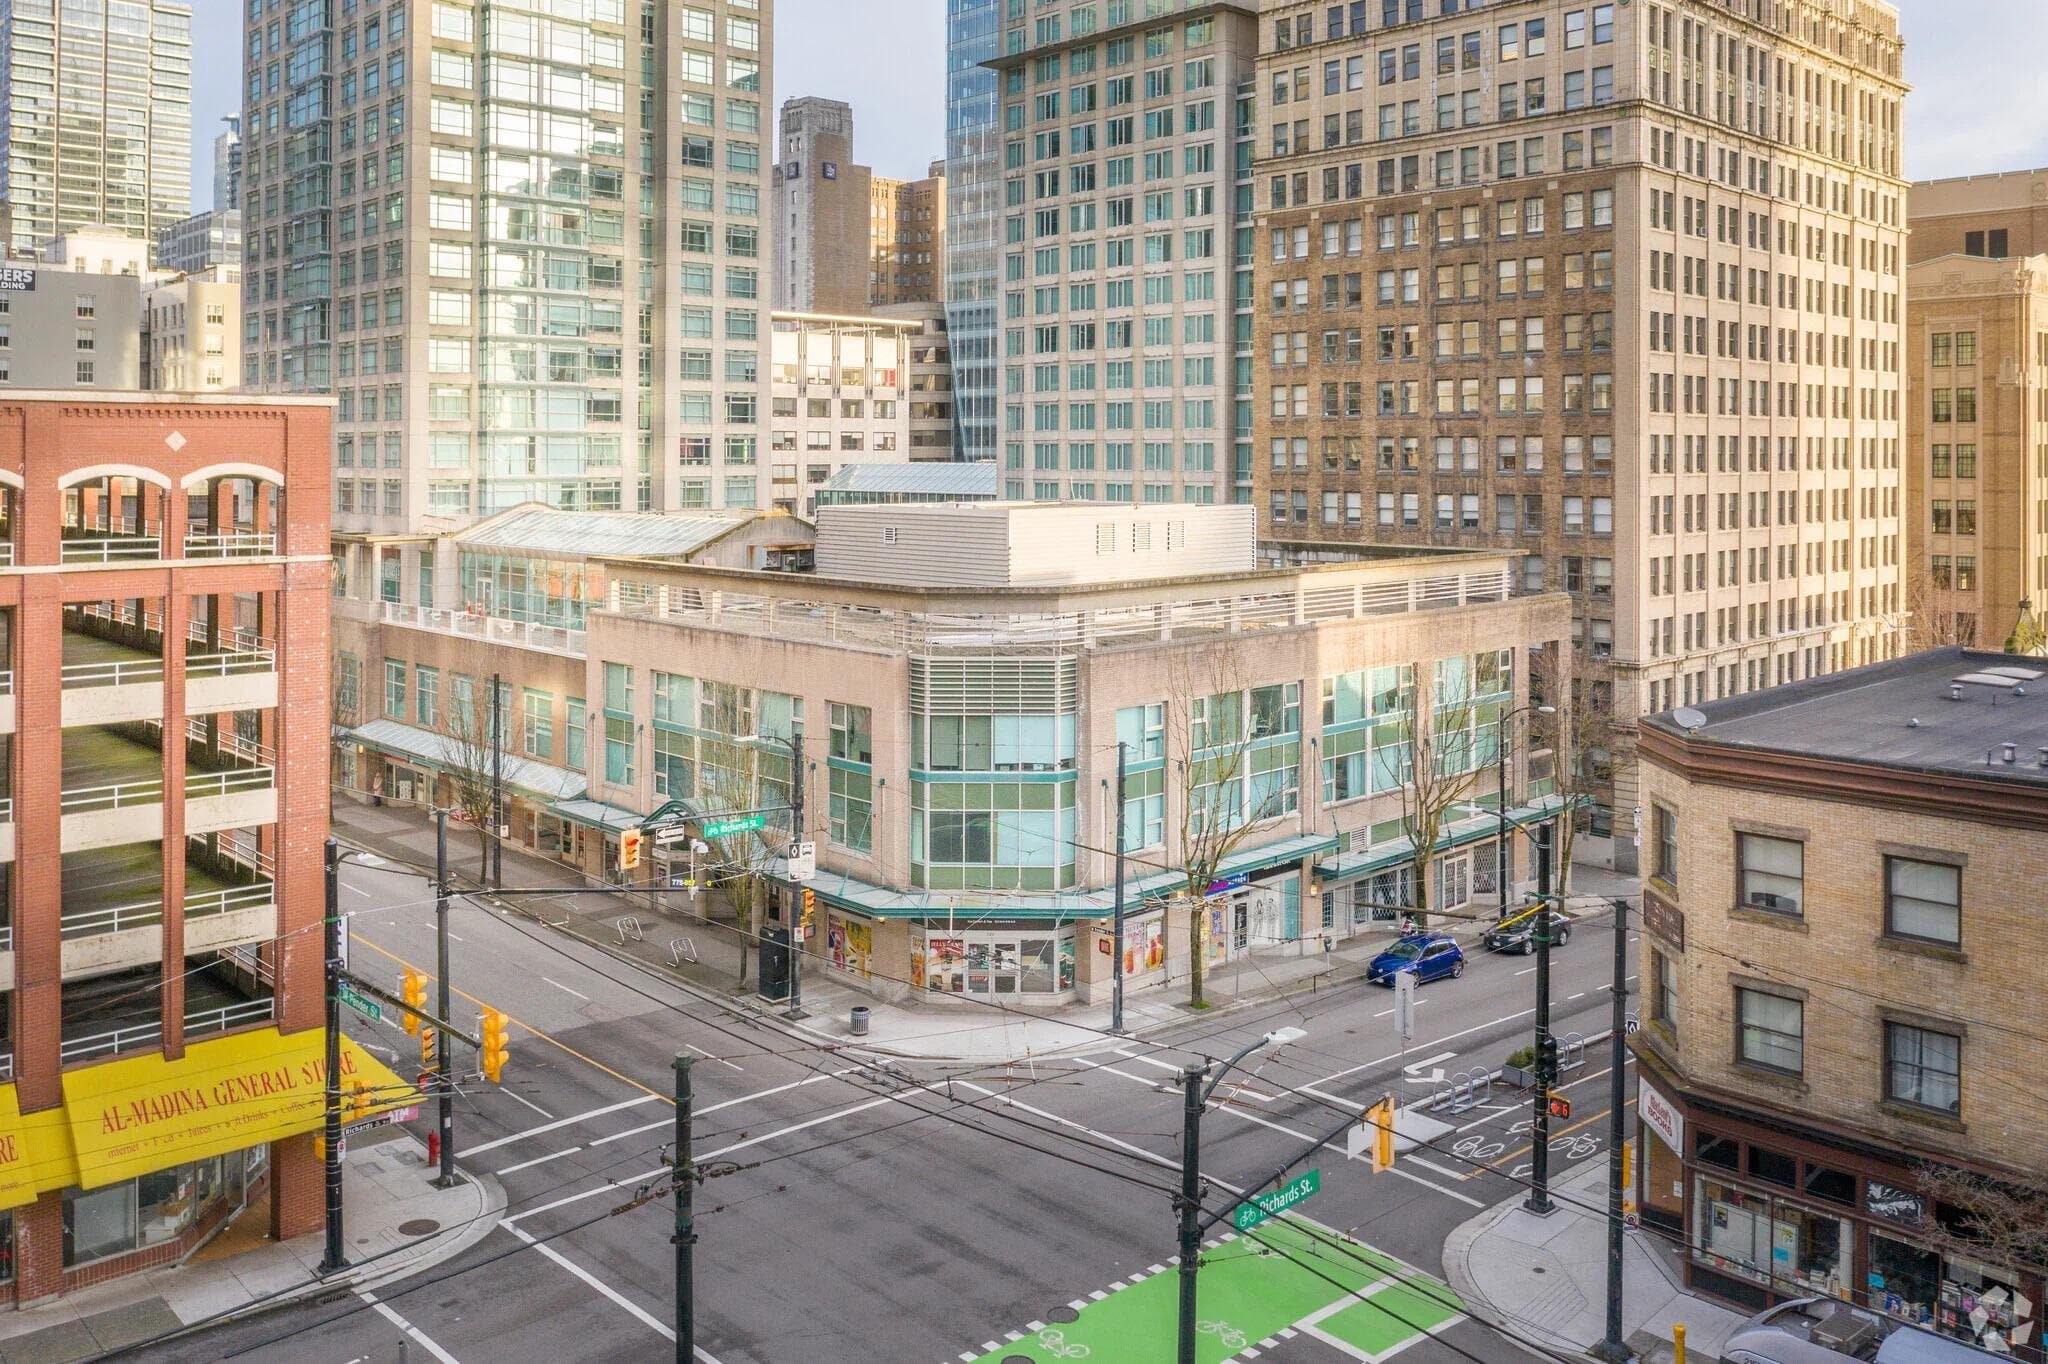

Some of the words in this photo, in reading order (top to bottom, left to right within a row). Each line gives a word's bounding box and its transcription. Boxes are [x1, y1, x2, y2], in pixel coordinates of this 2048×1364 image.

[0, 281, 25, 289] DING
[350, 993, 369, 1012] Pender
[102, 1087, 208, 1134] AL-MADINA
[213, 1066, 297, 1106] GENERAL
[387, 1106, 409, 1124] ATM
[1647, 1105, 1673, 1137] BOOKS
[345, 1120, 373, 1135] Richards
[1260, 1185, 1299, 1217] Richards
[1300, 1178, 1313, 1196] St.
